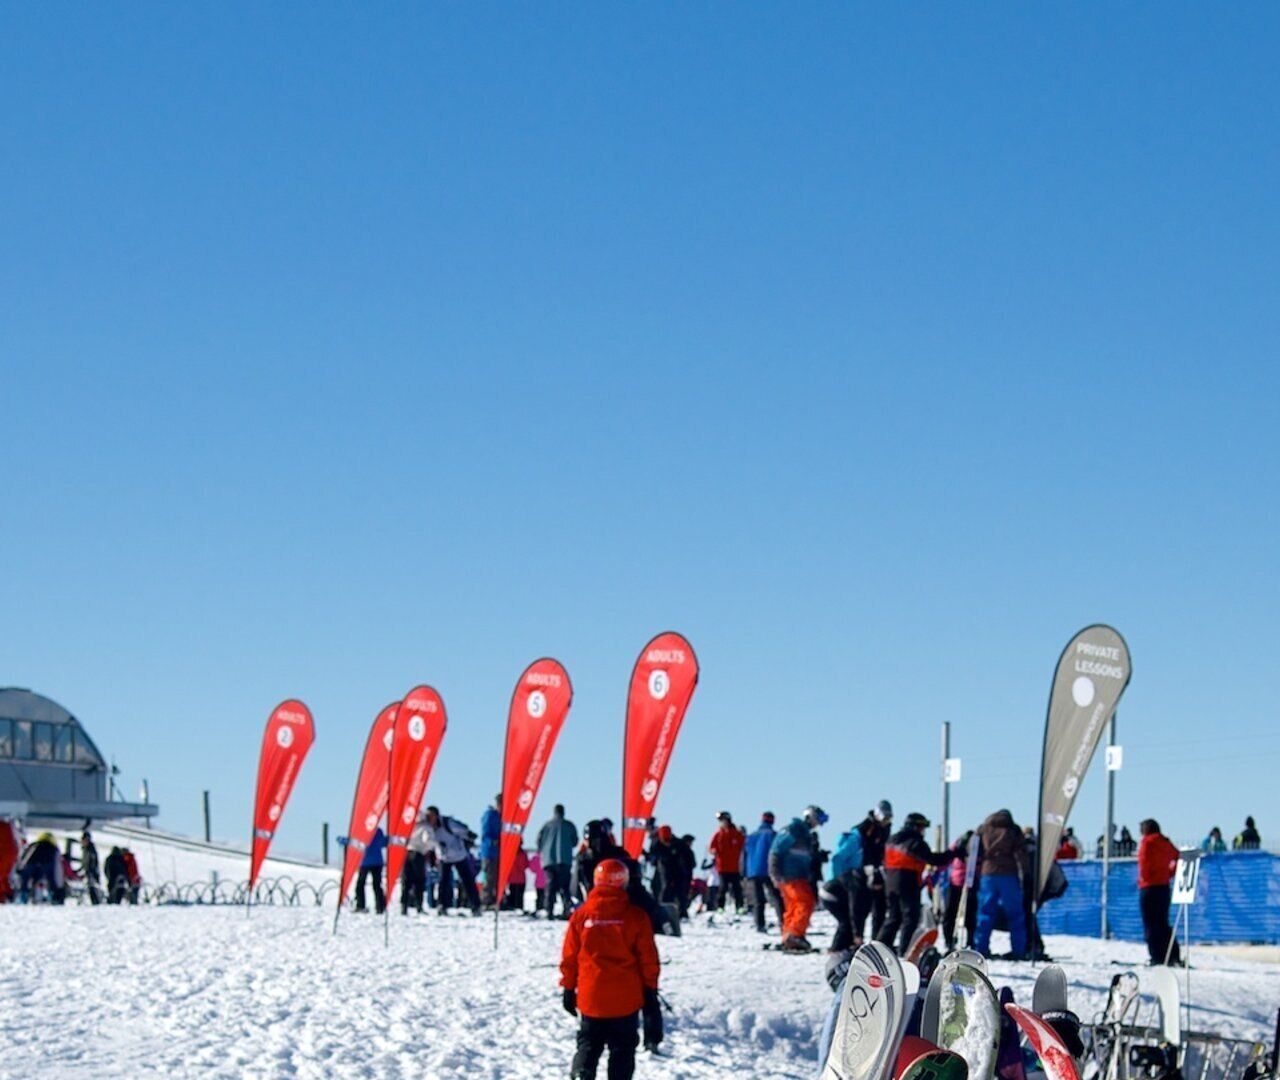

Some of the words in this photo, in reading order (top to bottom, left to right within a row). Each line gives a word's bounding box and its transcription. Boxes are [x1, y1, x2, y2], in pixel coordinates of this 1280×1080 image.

[646, 650, 684, 665] ADULTS
[1076, 641, 1120, 660] PRIVATE
[1075, 659, 1123, 679] LESSONS
[526, 672, 562, 689] ADULTS
[652, 673, 665, 694] 6
[407, 699, 438, 713] ADULTS
[531, 695, 541, 714] 5
